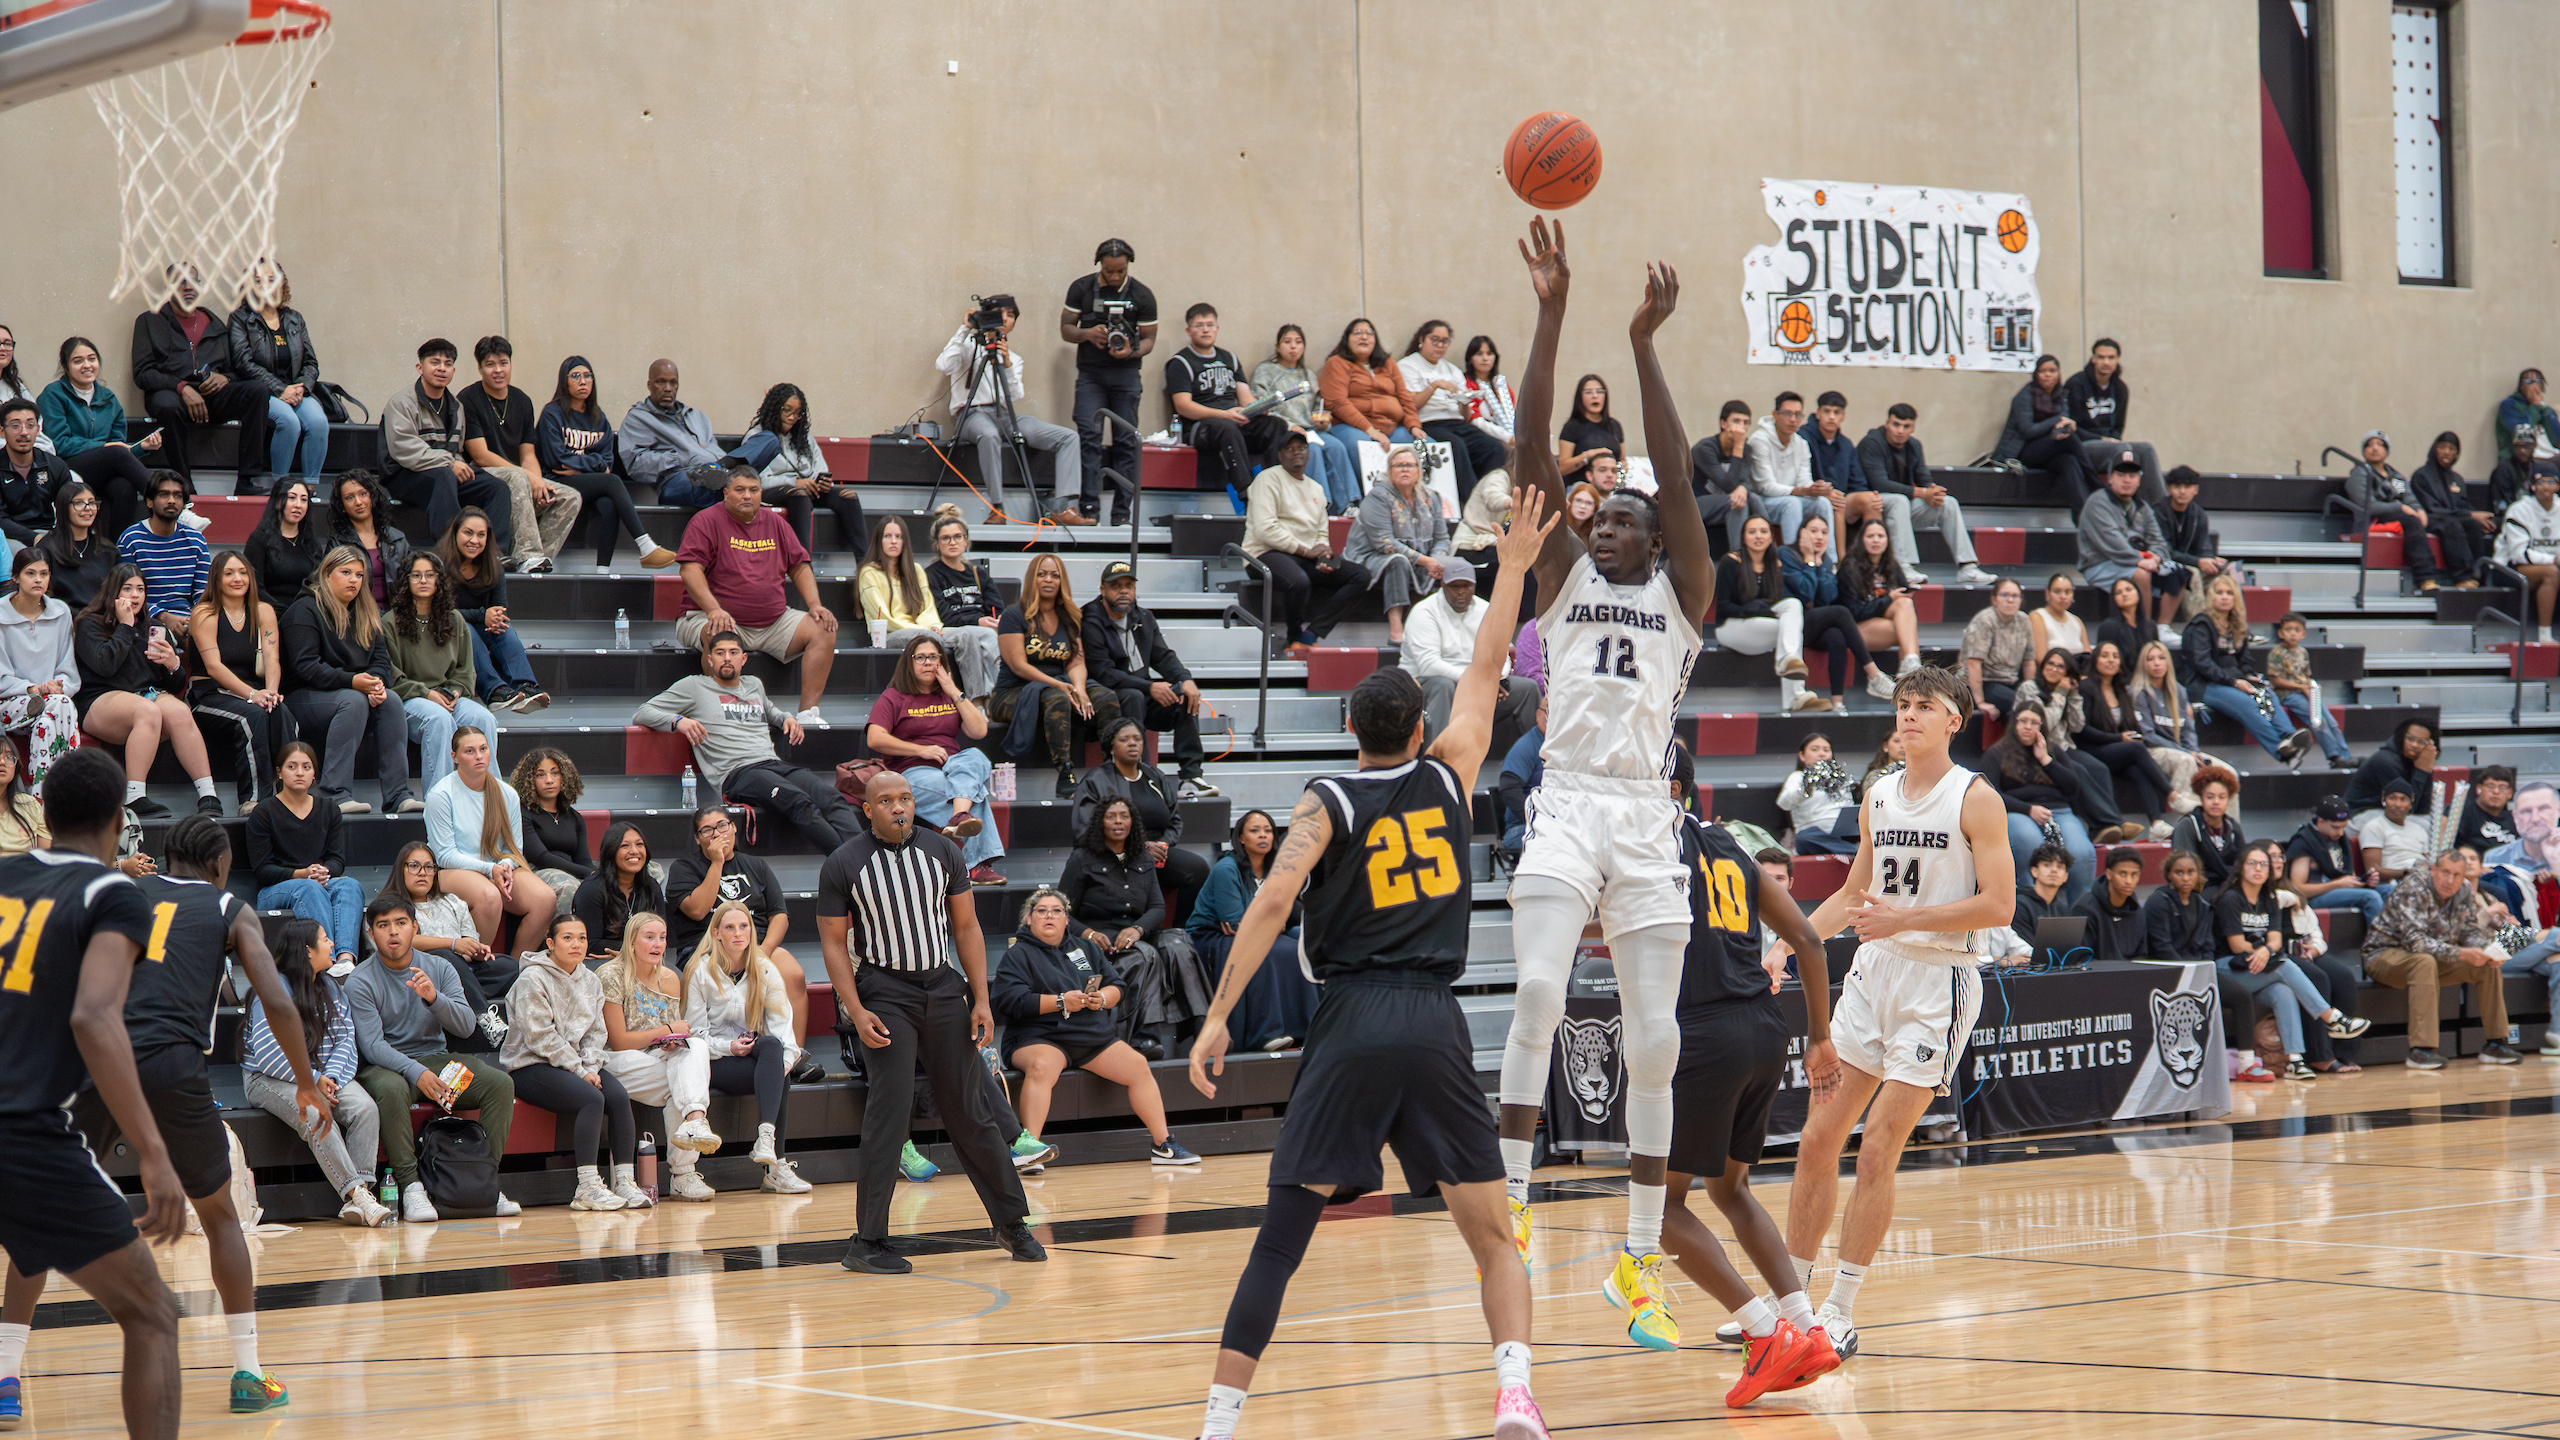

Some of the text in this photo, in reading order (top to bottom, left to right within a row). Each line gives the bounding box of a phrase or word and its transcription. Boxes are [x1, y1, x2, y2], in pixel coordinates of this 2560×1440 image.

[1537, 124, 1591, 174] SPALDING
[1786, 218, 1988, 296] STUDENT
[1827, 289, 1965, 356] SECTION
[730, 536, 776, 549] BASKETBALL
[1565, 603, 1667, 633] JAGUARS
[1592, 634, 1639, 681] 12
[720, 703, 765, 714] TRINITY
[907, 703, 957, 715] BASKETBALL
[1365, 806, 1463, 911] 25
[1873, 829, 1950, 850] JAGUARS
[1698, 851, 1750, 934] 10
[1881, 855, 1921, 897] 24
[1787, 1036, 1801, 1055] &M
[1972, 1028, 1996, 1047] TEXAS
[2020, 1016, 2092, 1042] UNIVERSITY-SAN
[2094, 1013, 2133, 1034] ANTONIO
[1973, 1039, 2133, 1082] ATHLETICS
